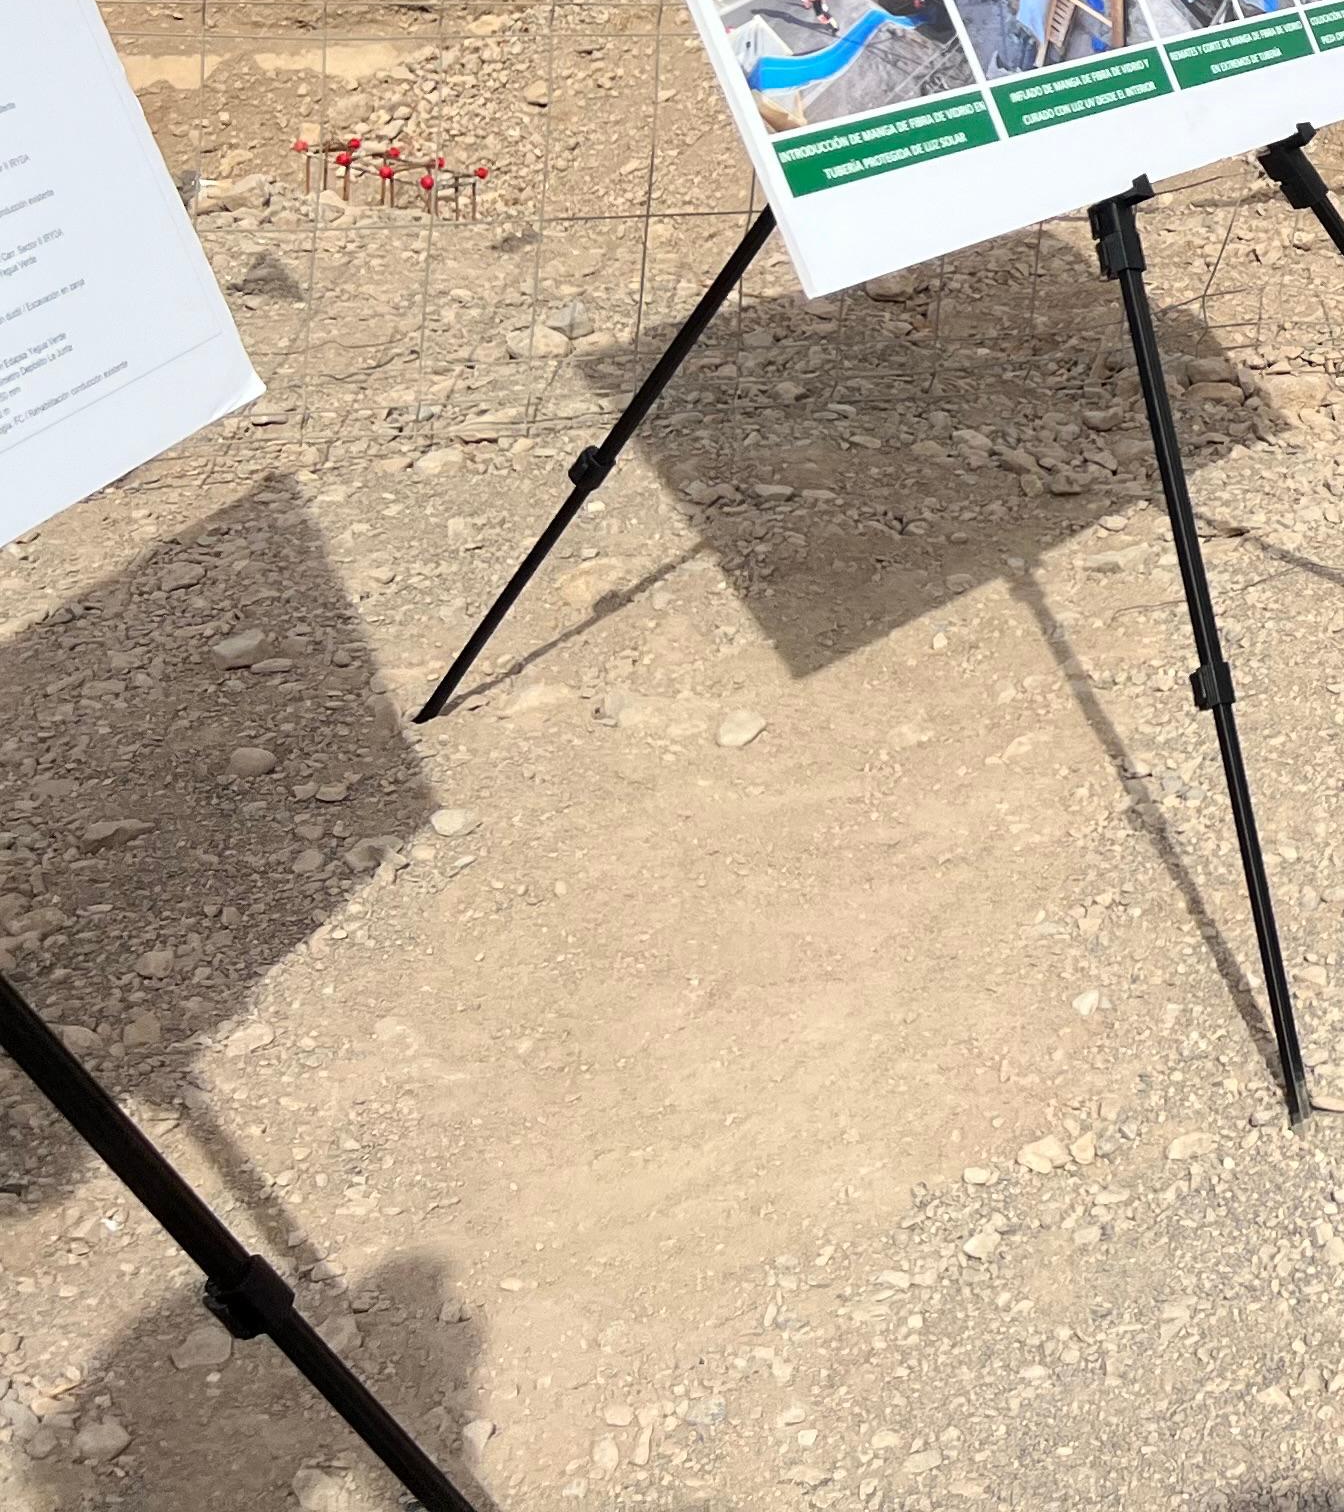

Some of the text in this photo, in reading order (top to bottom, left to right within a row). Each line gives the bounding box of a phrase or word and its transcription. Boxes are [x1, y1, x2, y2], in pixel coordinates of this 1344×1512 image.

[778, 101, 986, 162] INTRODUCCIÓN DE MANGA DE FIBRA DE VIDRIO EN
[823, 133, 967, 180] TUBERÍA PROTEGIDA DE LUZ SOLAR
